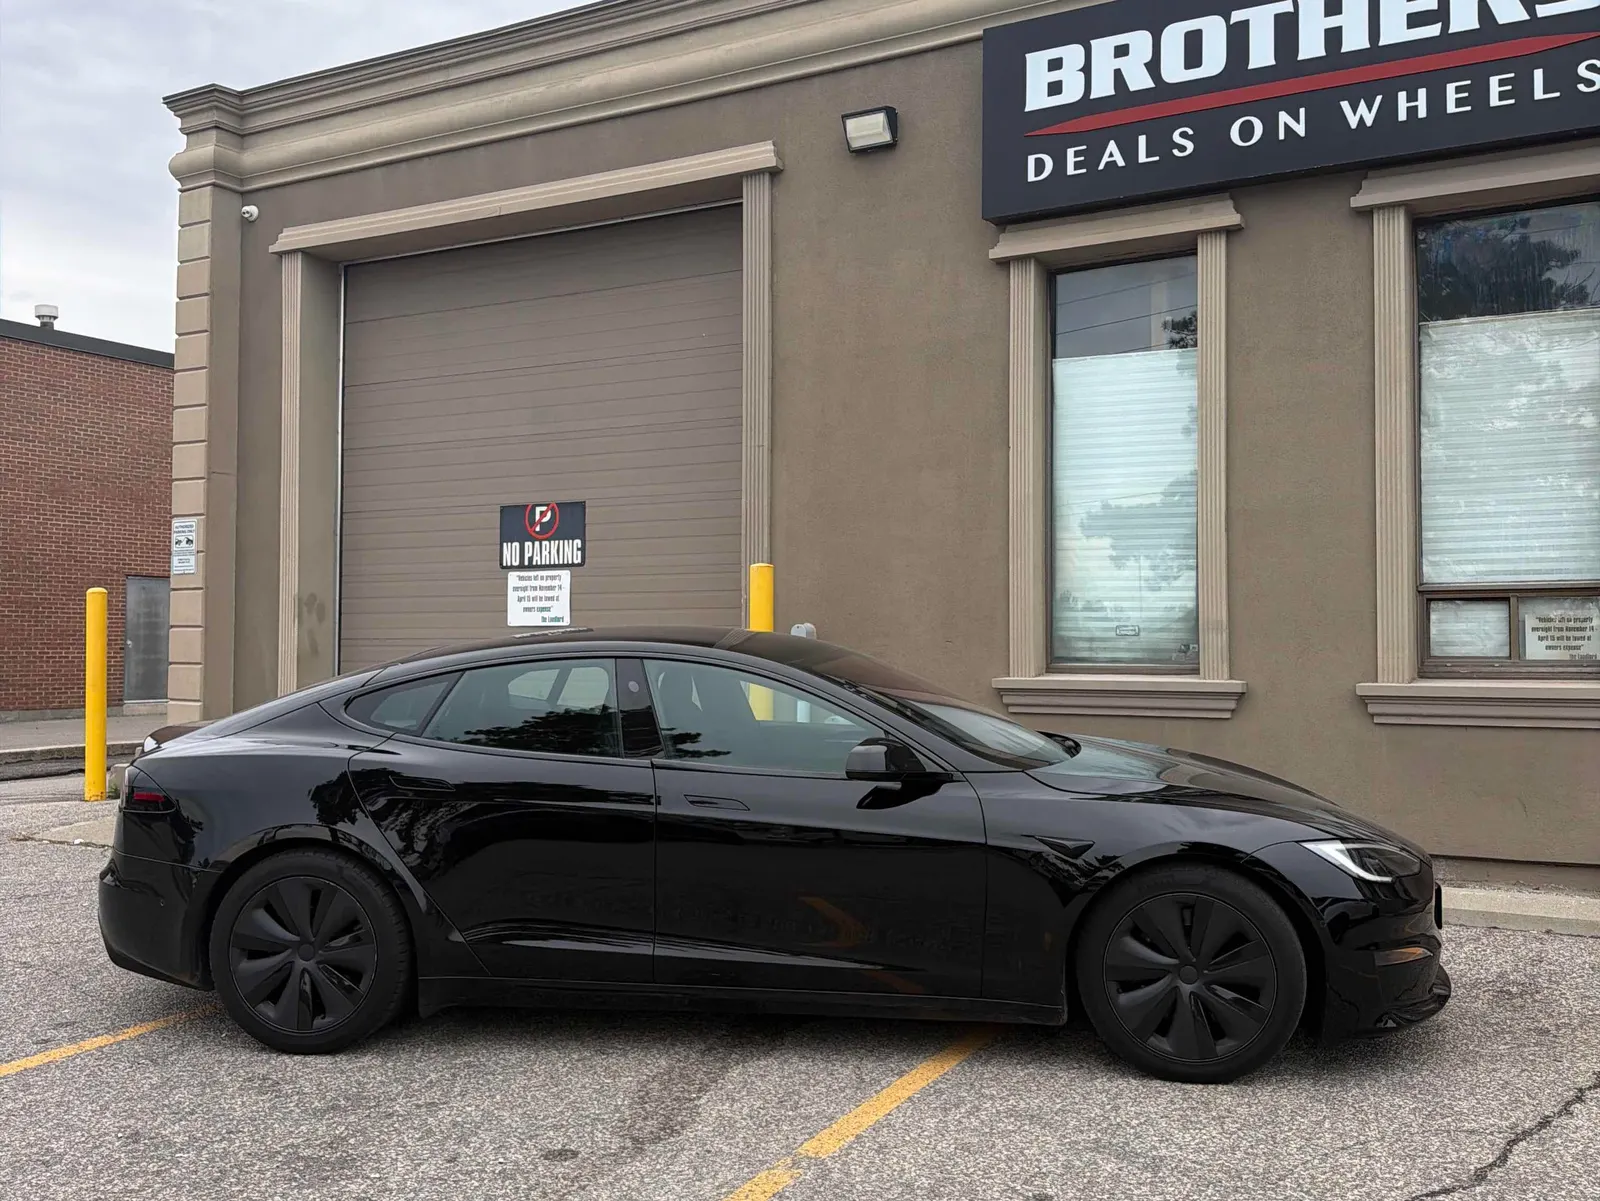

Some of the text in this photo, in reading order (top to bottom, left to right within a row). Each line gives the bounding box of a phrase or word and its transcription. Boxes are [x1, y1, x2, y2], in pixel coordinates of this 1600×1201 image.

[1024, 0, 1600, 112] BROTHER
[1027, 59, 1600, 182] DEALS ON WHEELS
[502, 539, 582, 566] NO PARKING
[545, 574, 562, 582] property
[517, 595, 526, 603] April
[1573, 616, 1594, 624] property
